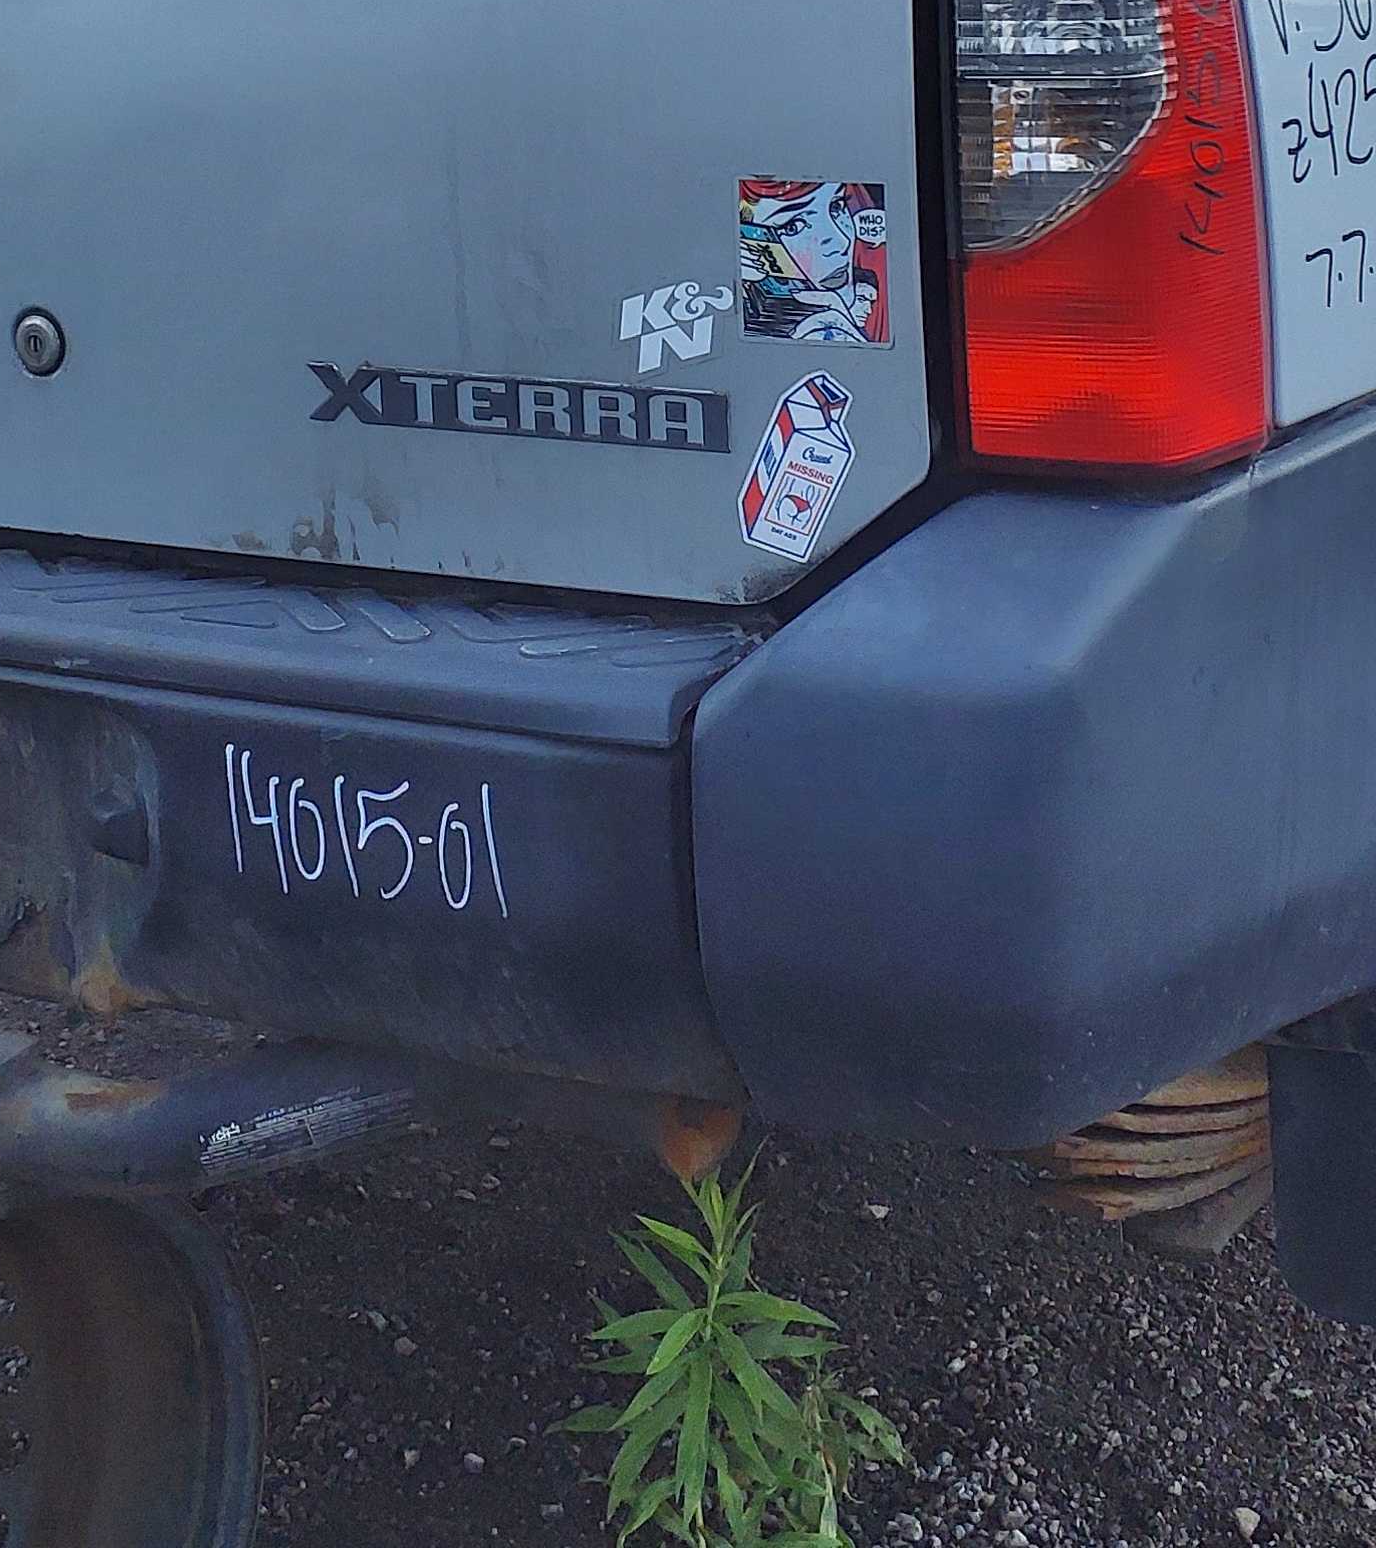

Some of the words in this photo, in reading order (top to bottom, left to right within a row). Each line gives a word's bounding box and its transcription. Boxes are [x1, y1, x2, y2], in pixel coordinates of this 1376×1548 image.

[859, 214, 883, 226] WHO
[859, 226, 885, 237] DIS?
[308, 360, 707, 449] XTERRA
[787, 460, 834, 484] MISSING
[226, 743, 508, 918] 14015-01
